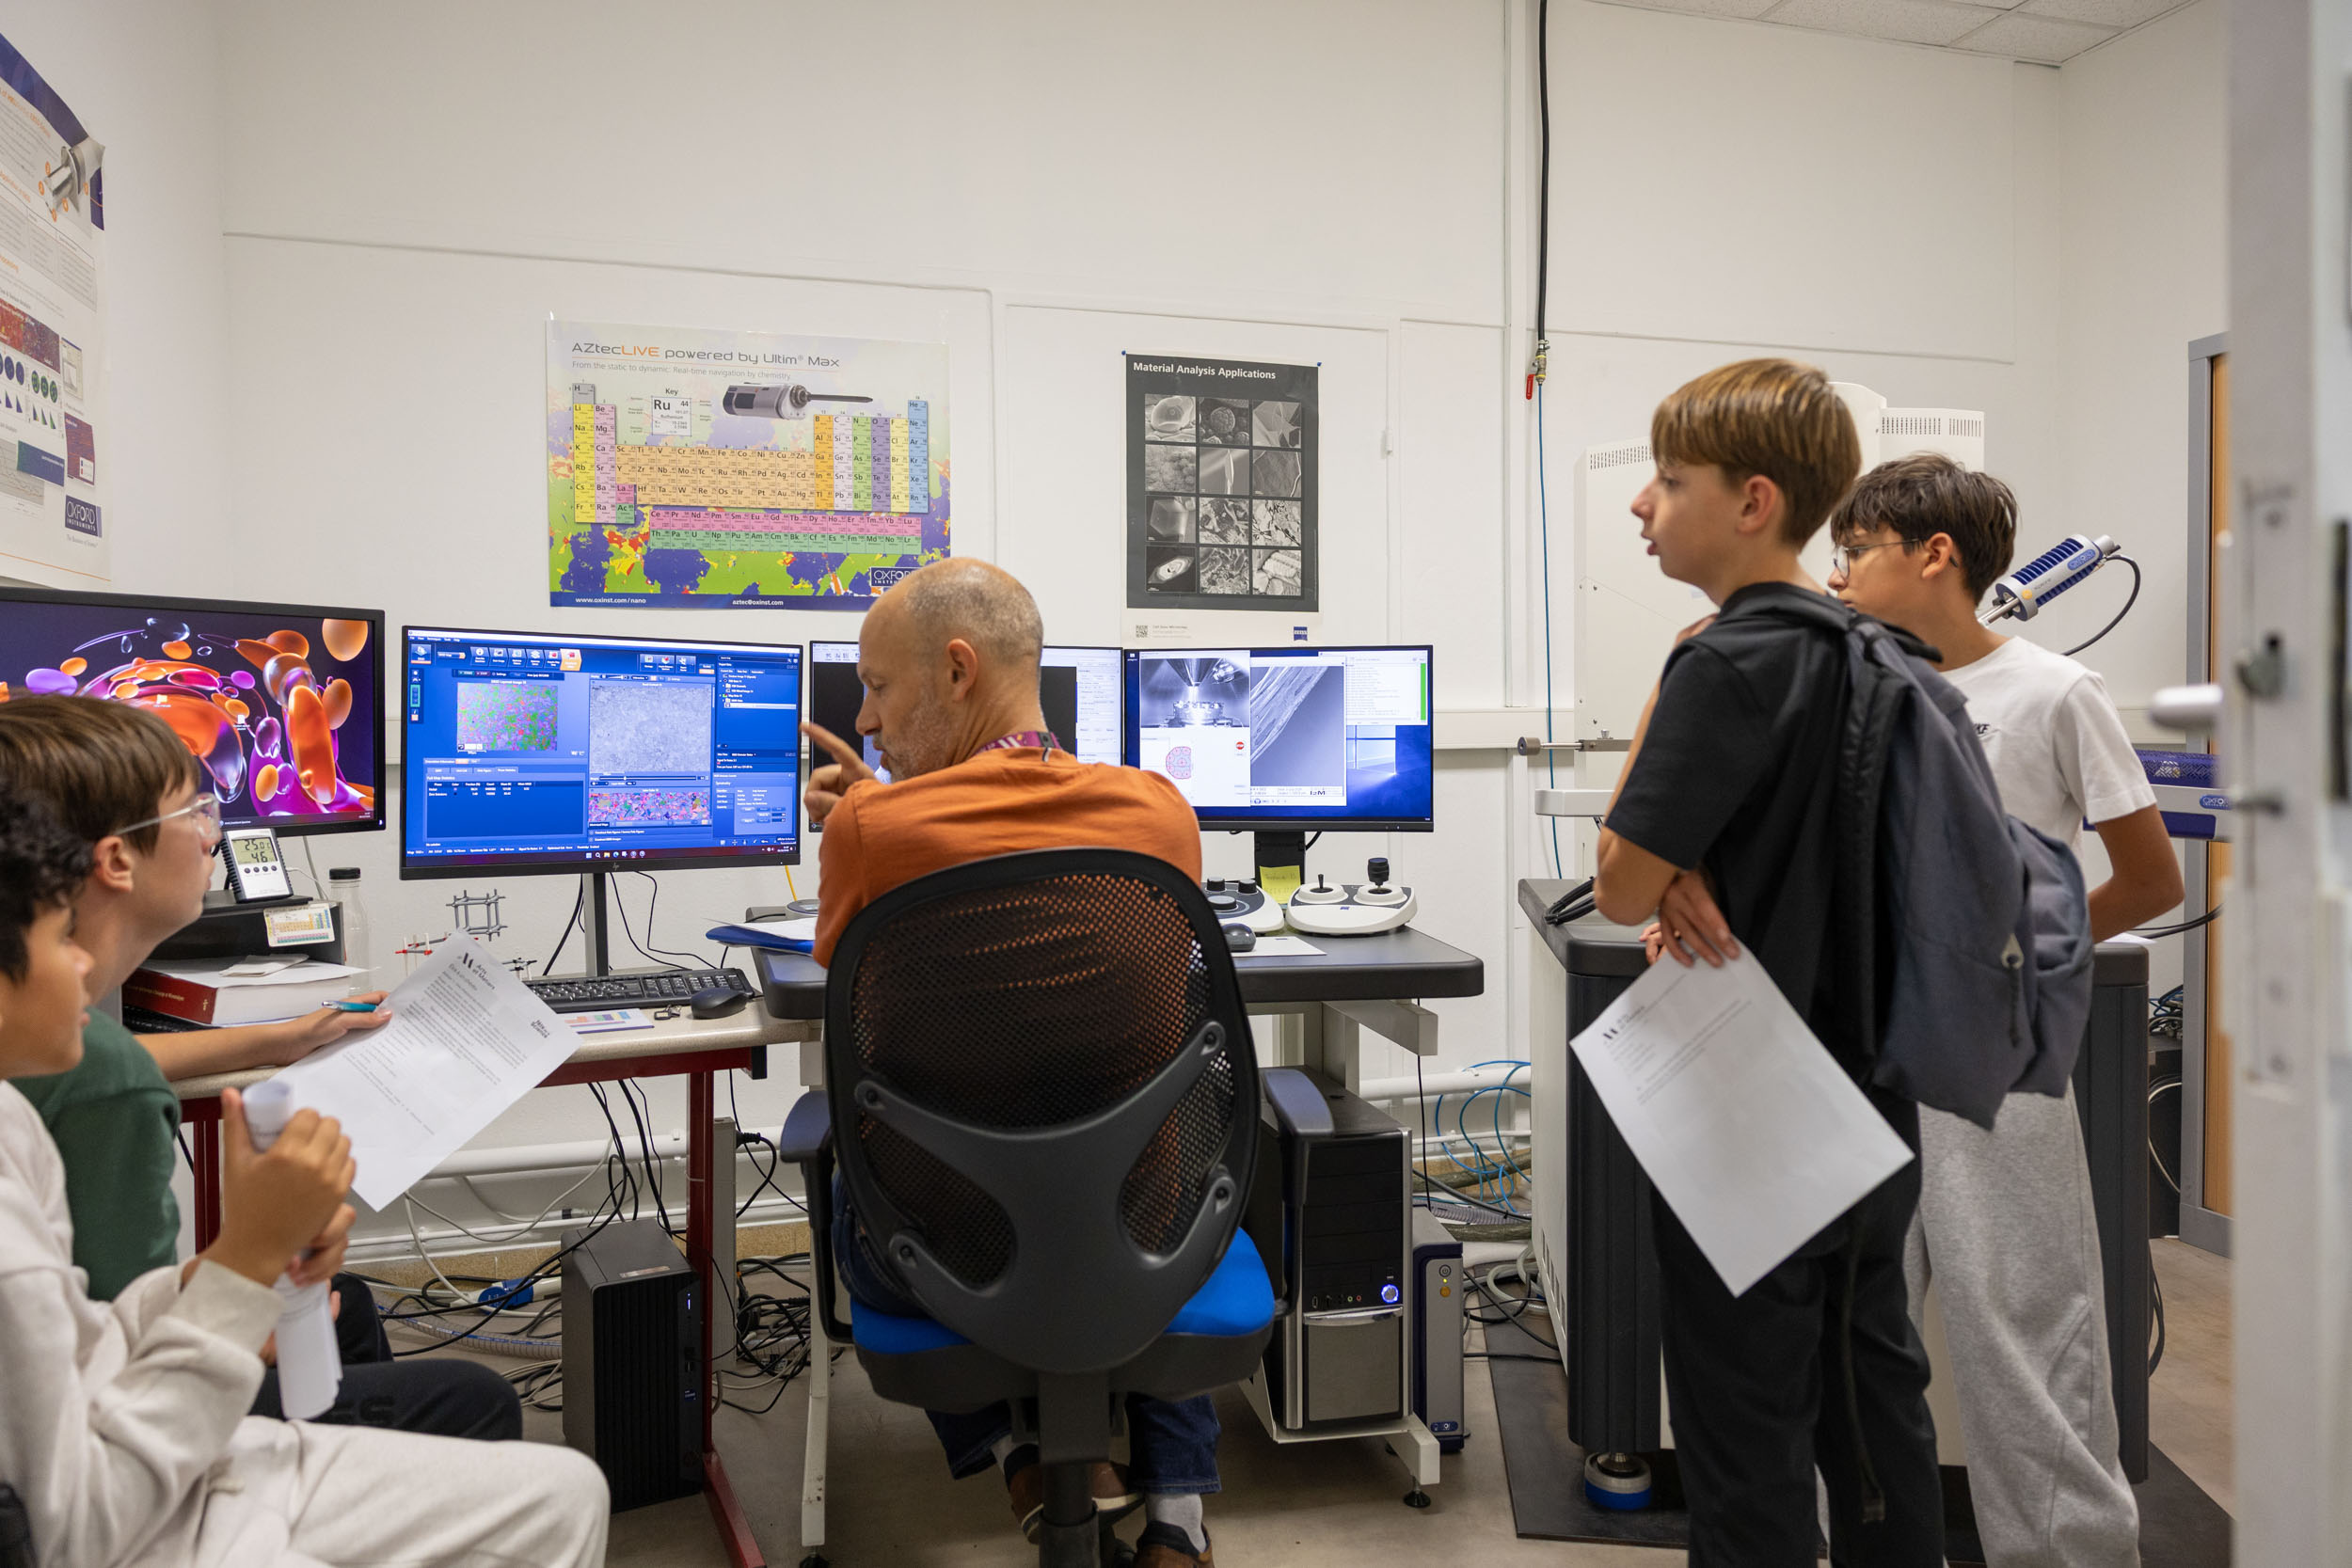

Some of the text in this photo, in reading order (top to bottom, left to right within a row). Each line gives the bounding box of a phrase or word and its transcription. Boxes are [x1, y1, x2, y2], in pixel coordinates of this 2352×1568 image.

[664, 349, 733, 361] powered
[739, 352, 758, 364] by
[808, 356, 839, 367] Max
[594, 361, 606, 370] the
[673, 366, 707, 375] Real-time
[708, 369, 745, 378] navigation
[758, 372, 790, 381] chemistry
[1134, 362, 1276, 379] Material Analysis Applications
[654, 400, 671, 410] Ru
[67, 501, 95, 524] OXFORD
[67, 518, 96, 531] INSTRUMENTS
[251, 851, 268, 863] 46
